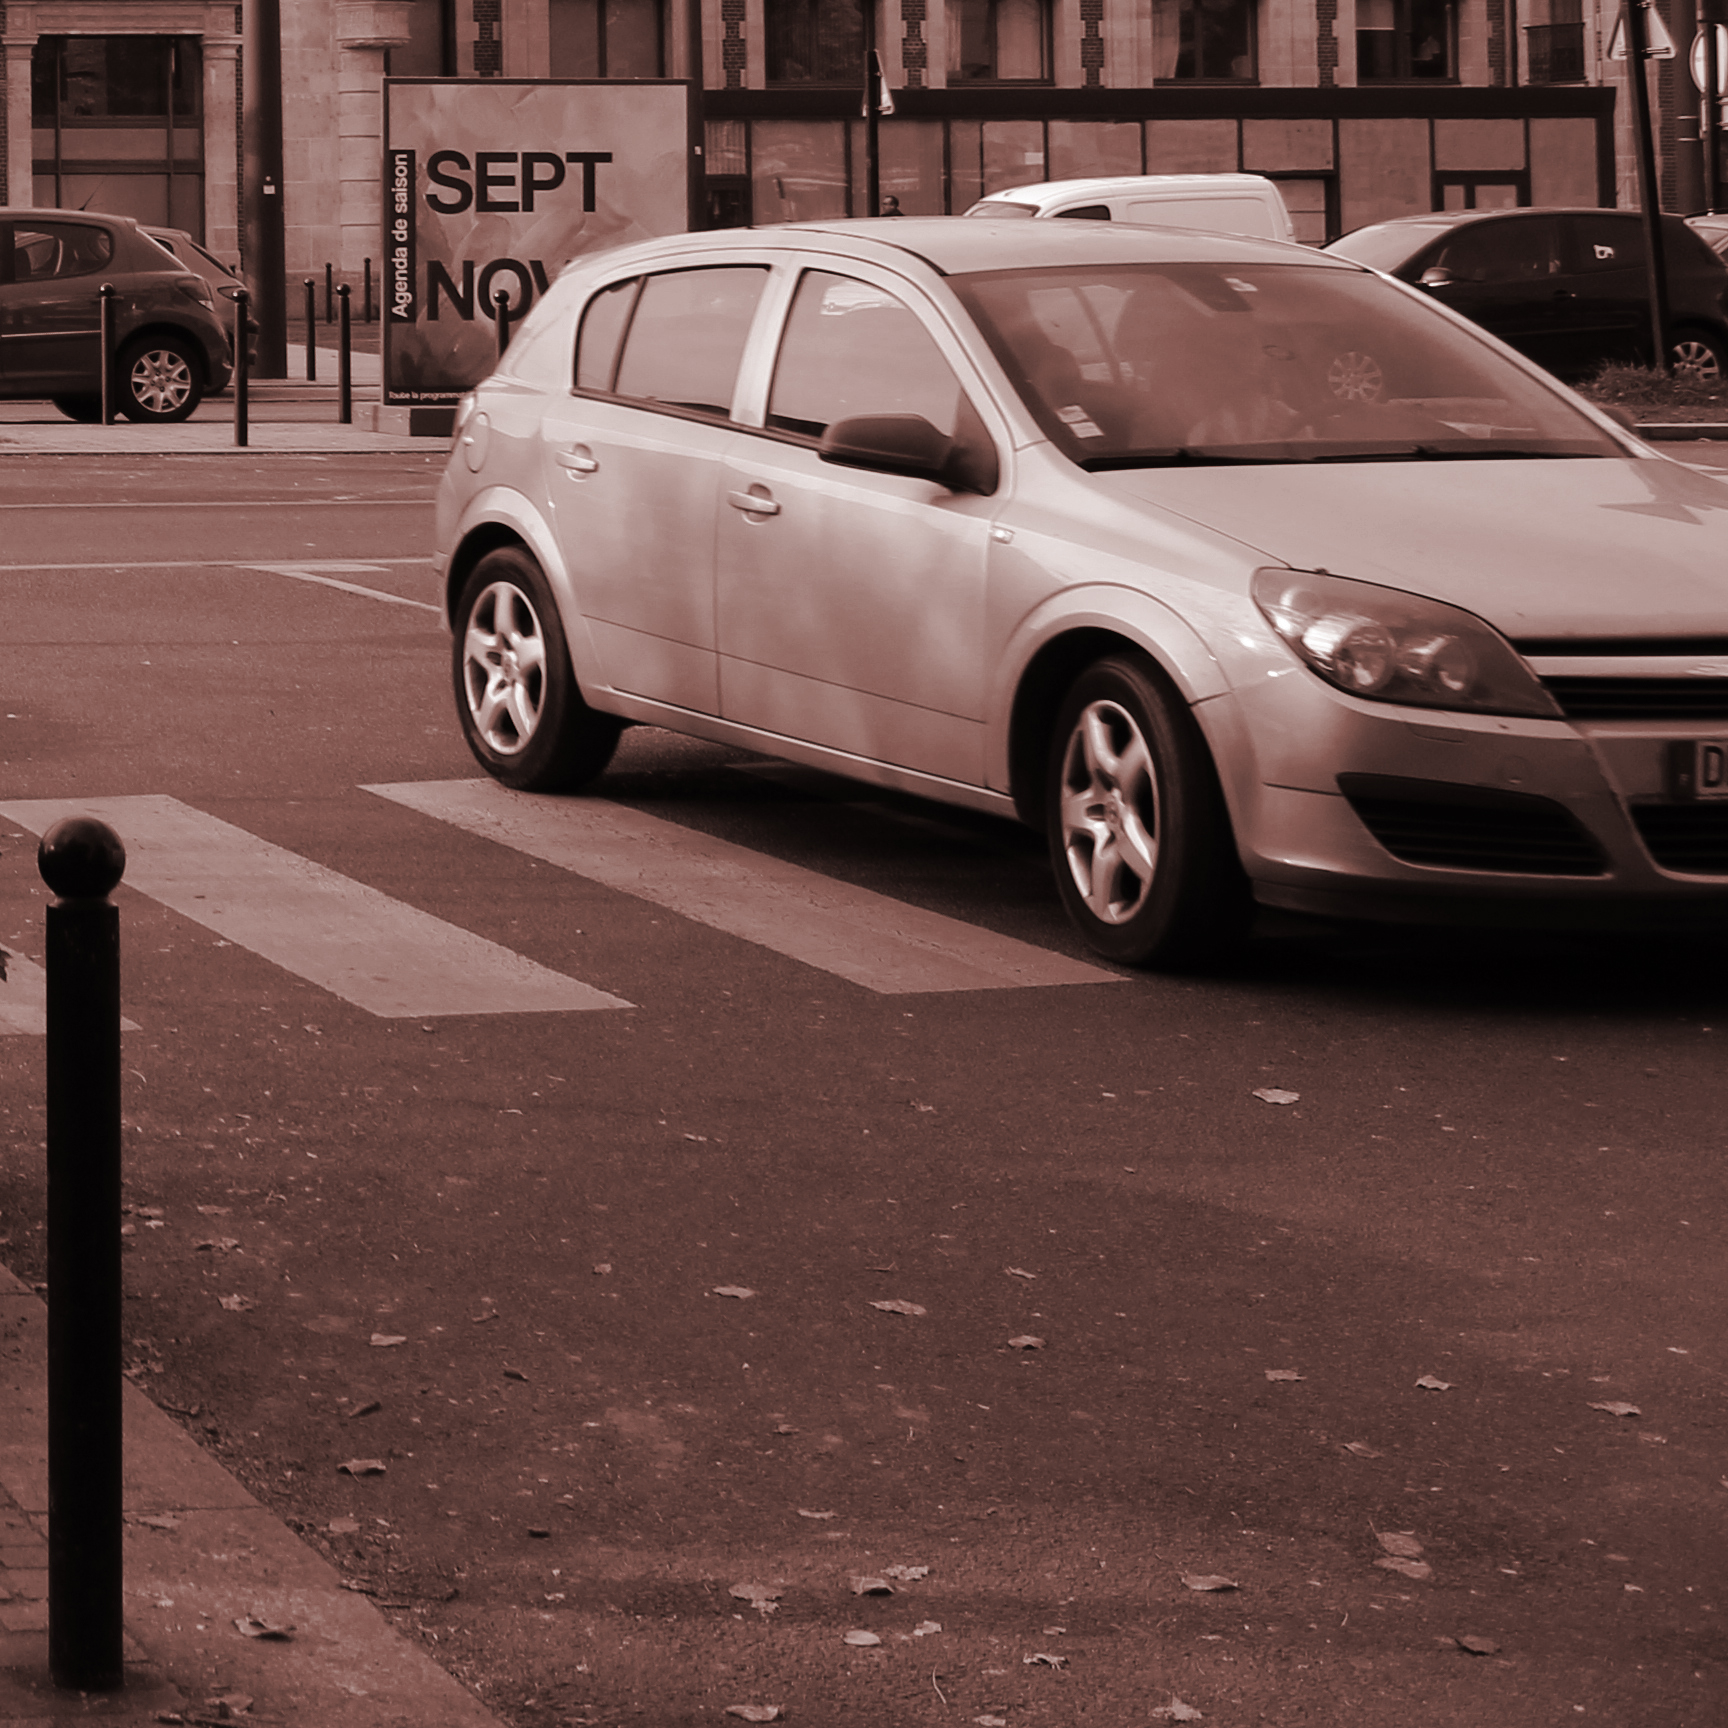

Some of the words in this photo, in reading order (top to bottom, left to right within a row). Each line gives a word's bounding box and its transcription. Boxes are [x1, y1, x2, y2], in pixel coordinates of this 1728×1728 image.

[391, 153, 408, 214] saison
[425, 150, 613, 214] SEPT
[391, 219, 408, 242] de
[391, 247, 413, 318] Agenda
